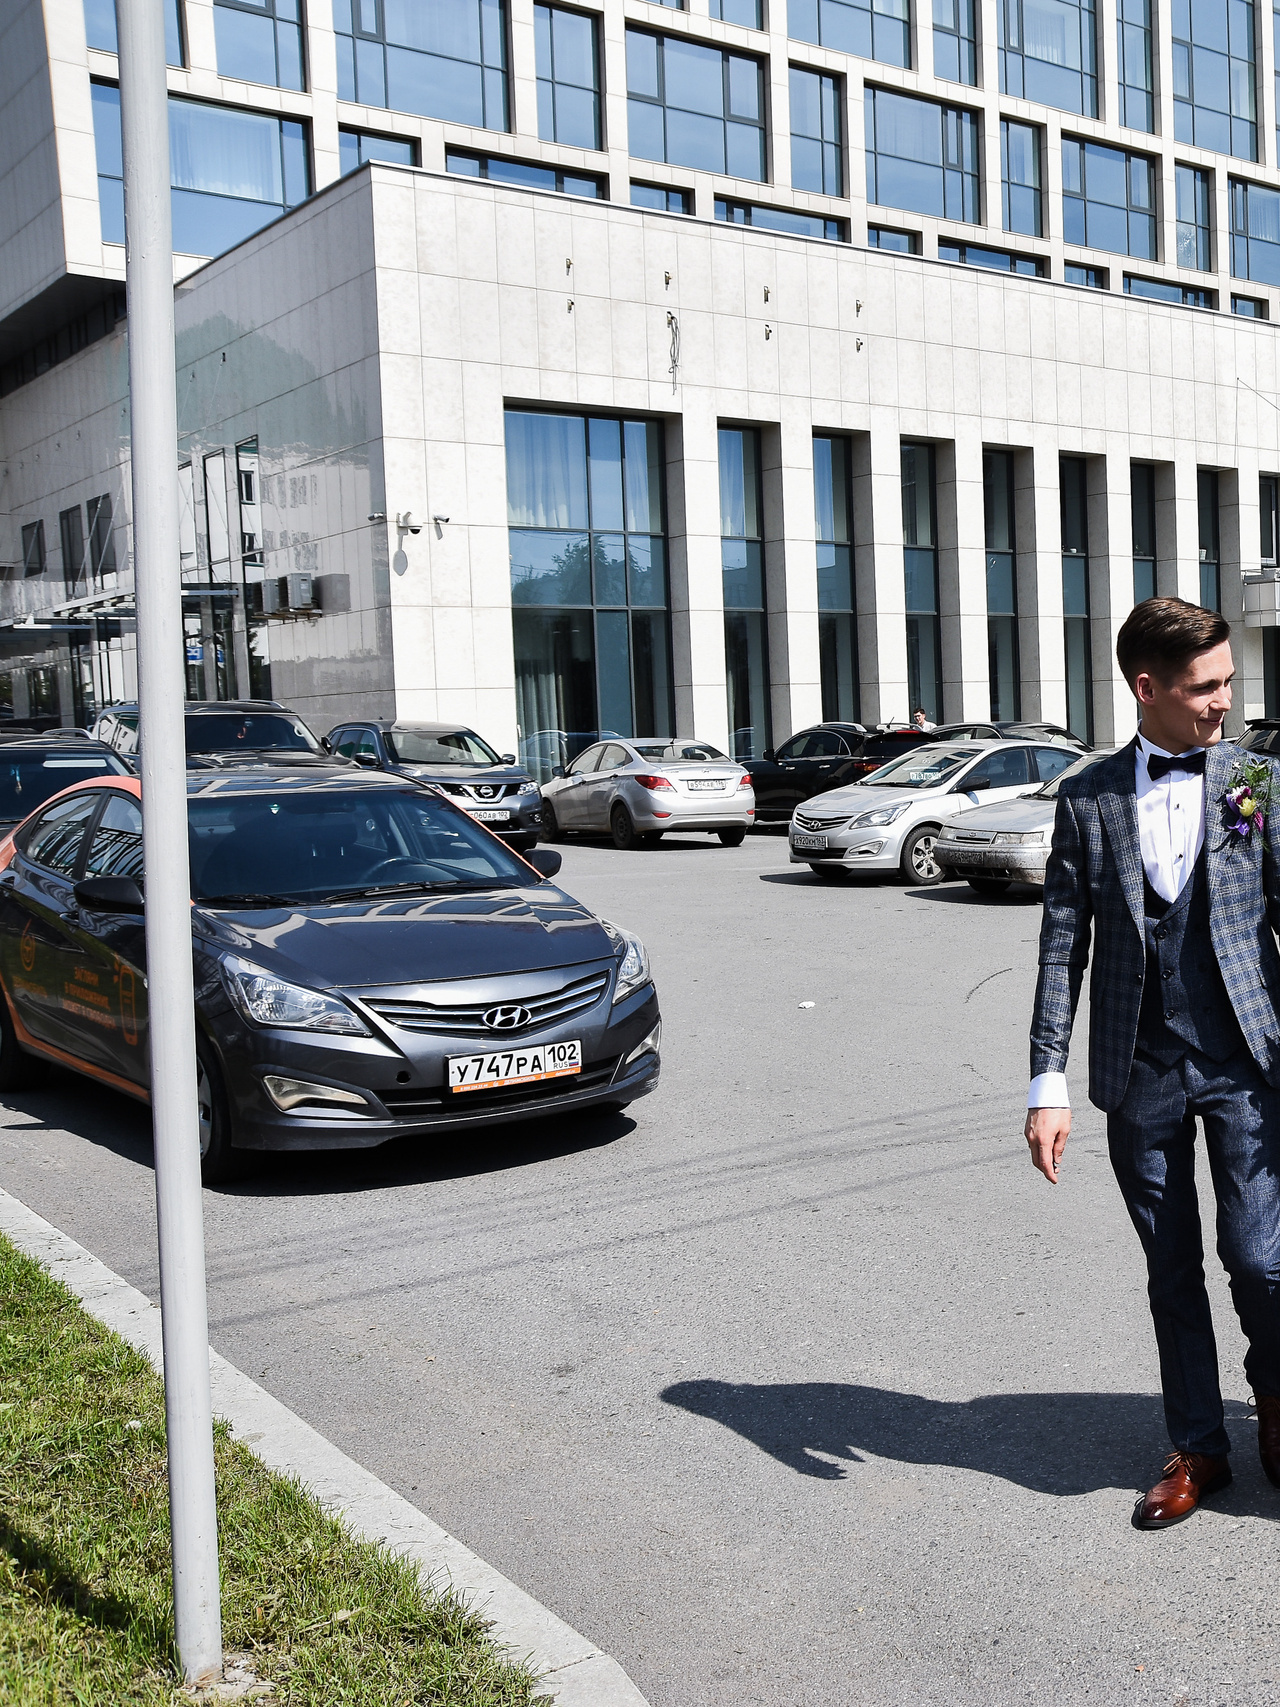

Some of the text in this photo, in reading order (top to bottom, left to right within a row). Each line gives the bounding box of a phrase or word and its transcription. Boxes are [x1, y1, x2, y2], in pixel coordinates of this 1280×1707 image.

[457, 1054, 542, 1082] У747РА
[547, 1043, 577, 1063] 102
[553, 1061, 568, 1070] RUS
